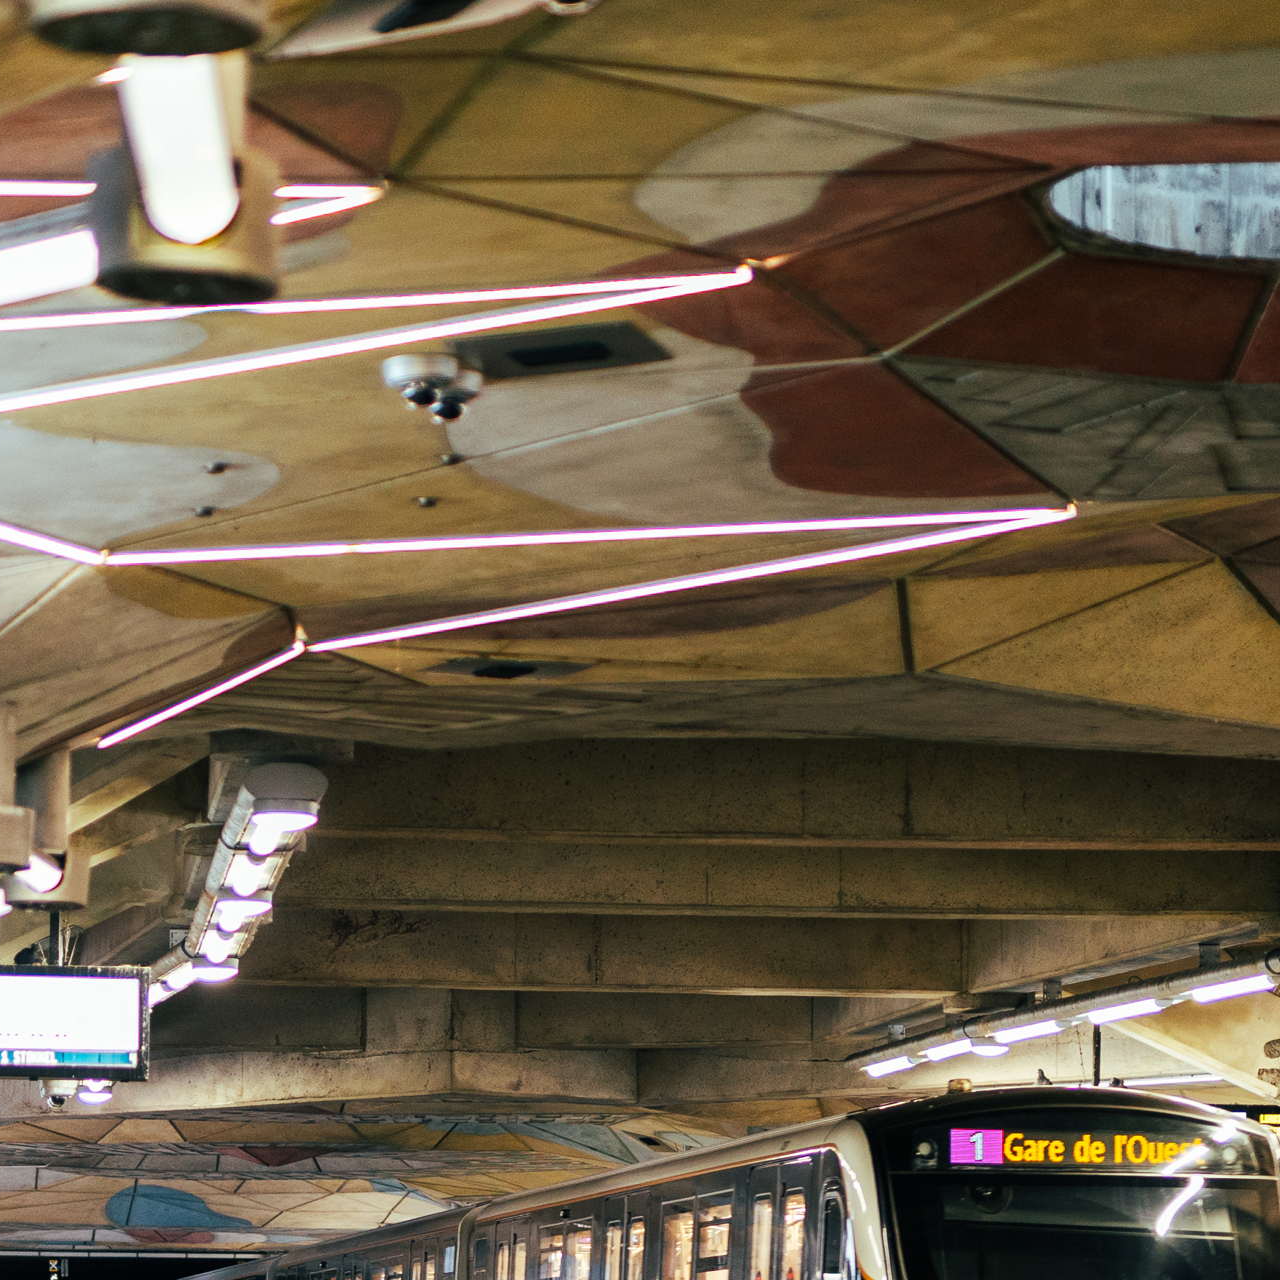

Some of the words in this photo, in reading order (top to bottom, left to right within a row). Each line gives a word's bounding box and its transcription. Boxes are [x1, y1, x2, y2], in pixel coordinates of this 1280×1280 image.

[969, 1131, 983, 1161] 1
[1003, 1133, 1065, 1163] Gare
[1073, 1134, 1106, 1164] de
